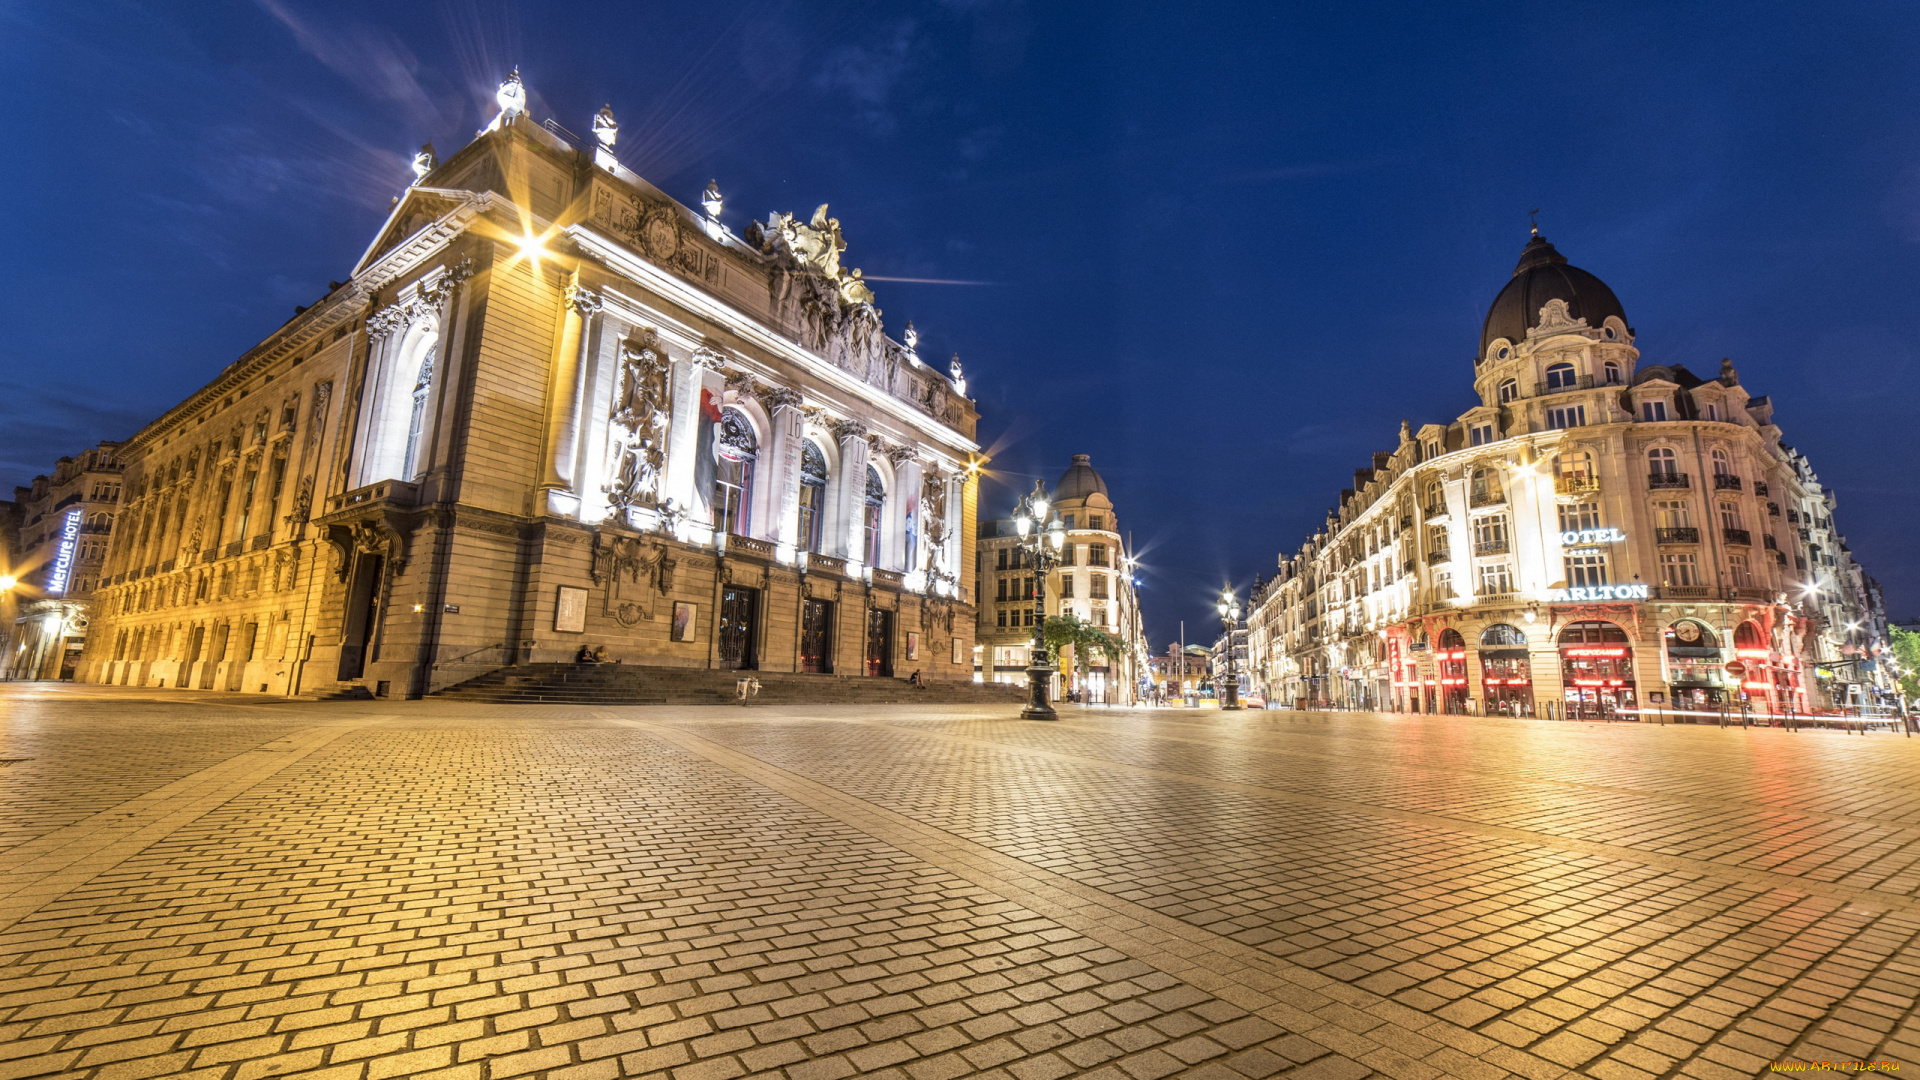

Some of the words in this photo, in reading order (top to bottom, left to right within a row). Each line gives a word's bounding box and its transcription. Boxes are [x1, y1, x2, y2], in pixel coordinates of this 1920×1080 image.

[788, 411, 802, 439] 16
[855, 441, 866, 465] 17
[48, 541, 74, 592] Mercure
[63, 510, 81, 540] HOTEL
[1389, 637, 1399, 672] HIPPO
